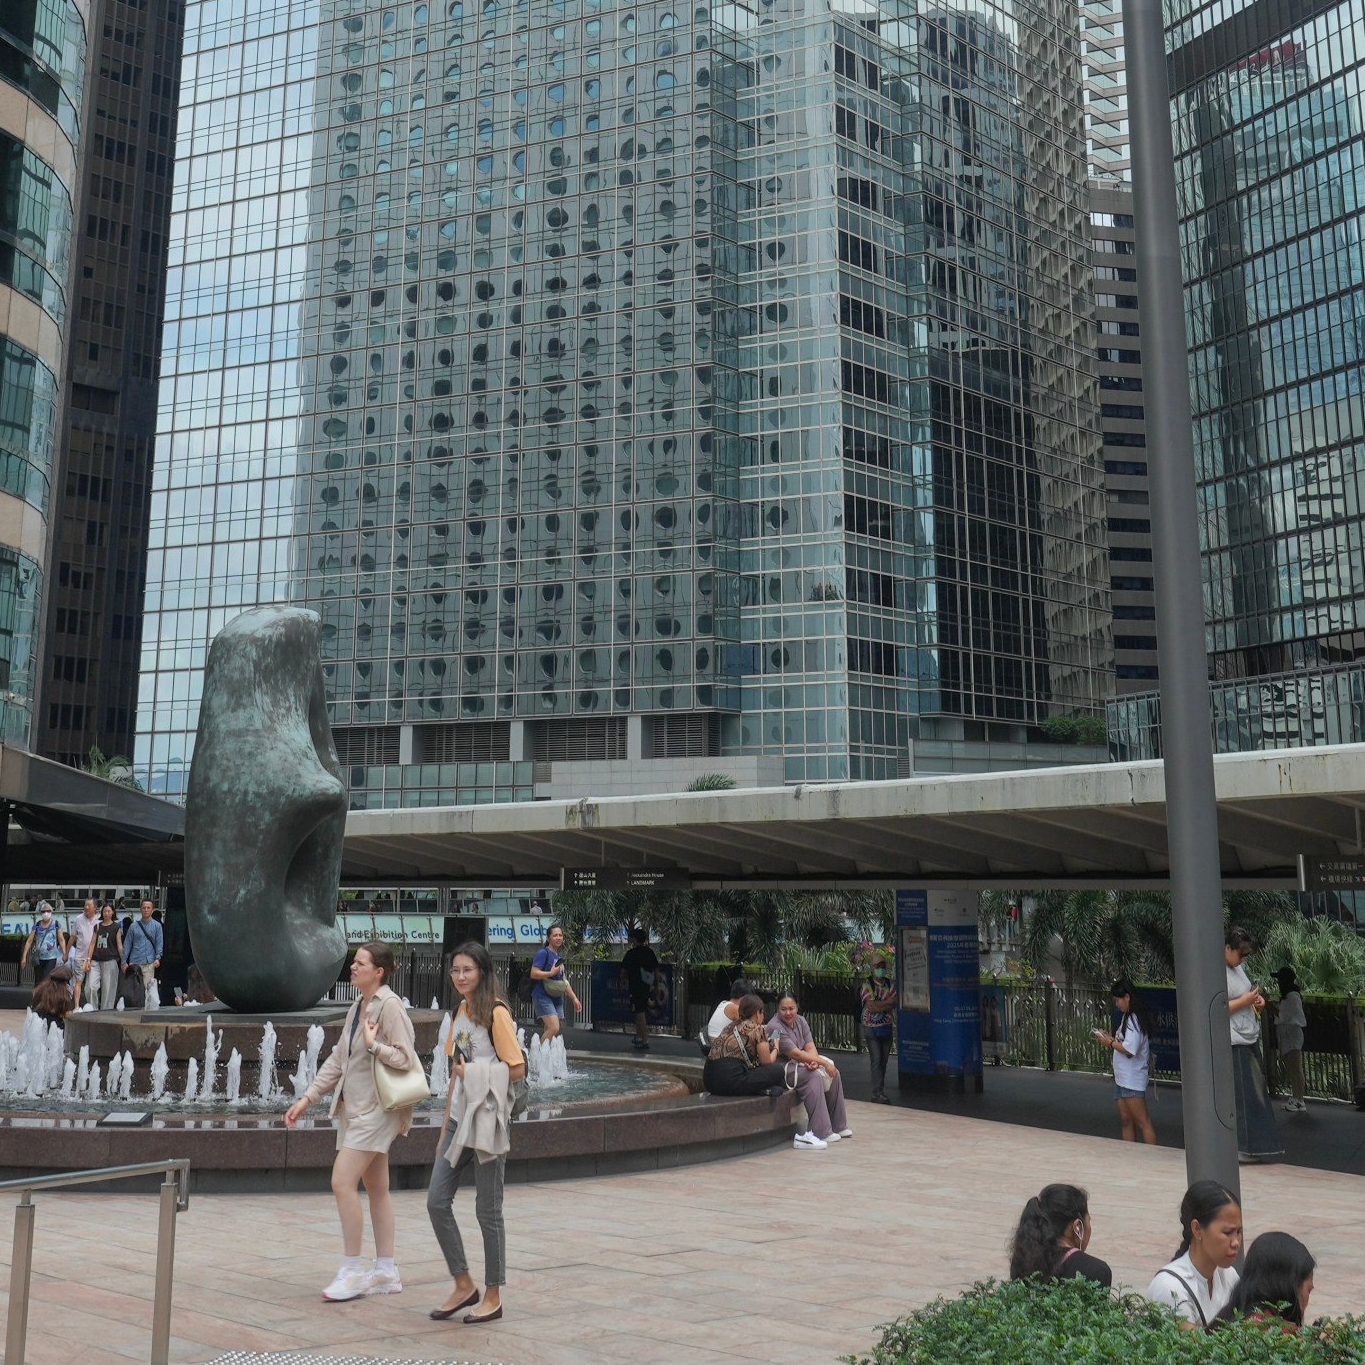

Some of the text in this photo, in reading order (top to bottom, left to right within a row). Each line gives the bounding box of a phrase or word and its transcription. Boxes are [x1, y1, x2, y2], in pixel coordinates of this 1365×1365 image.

[364, 928, 409, 939] Exhibition
[411, 929, 440, 939] Centre
[520, 924, 548, 937] Glob
